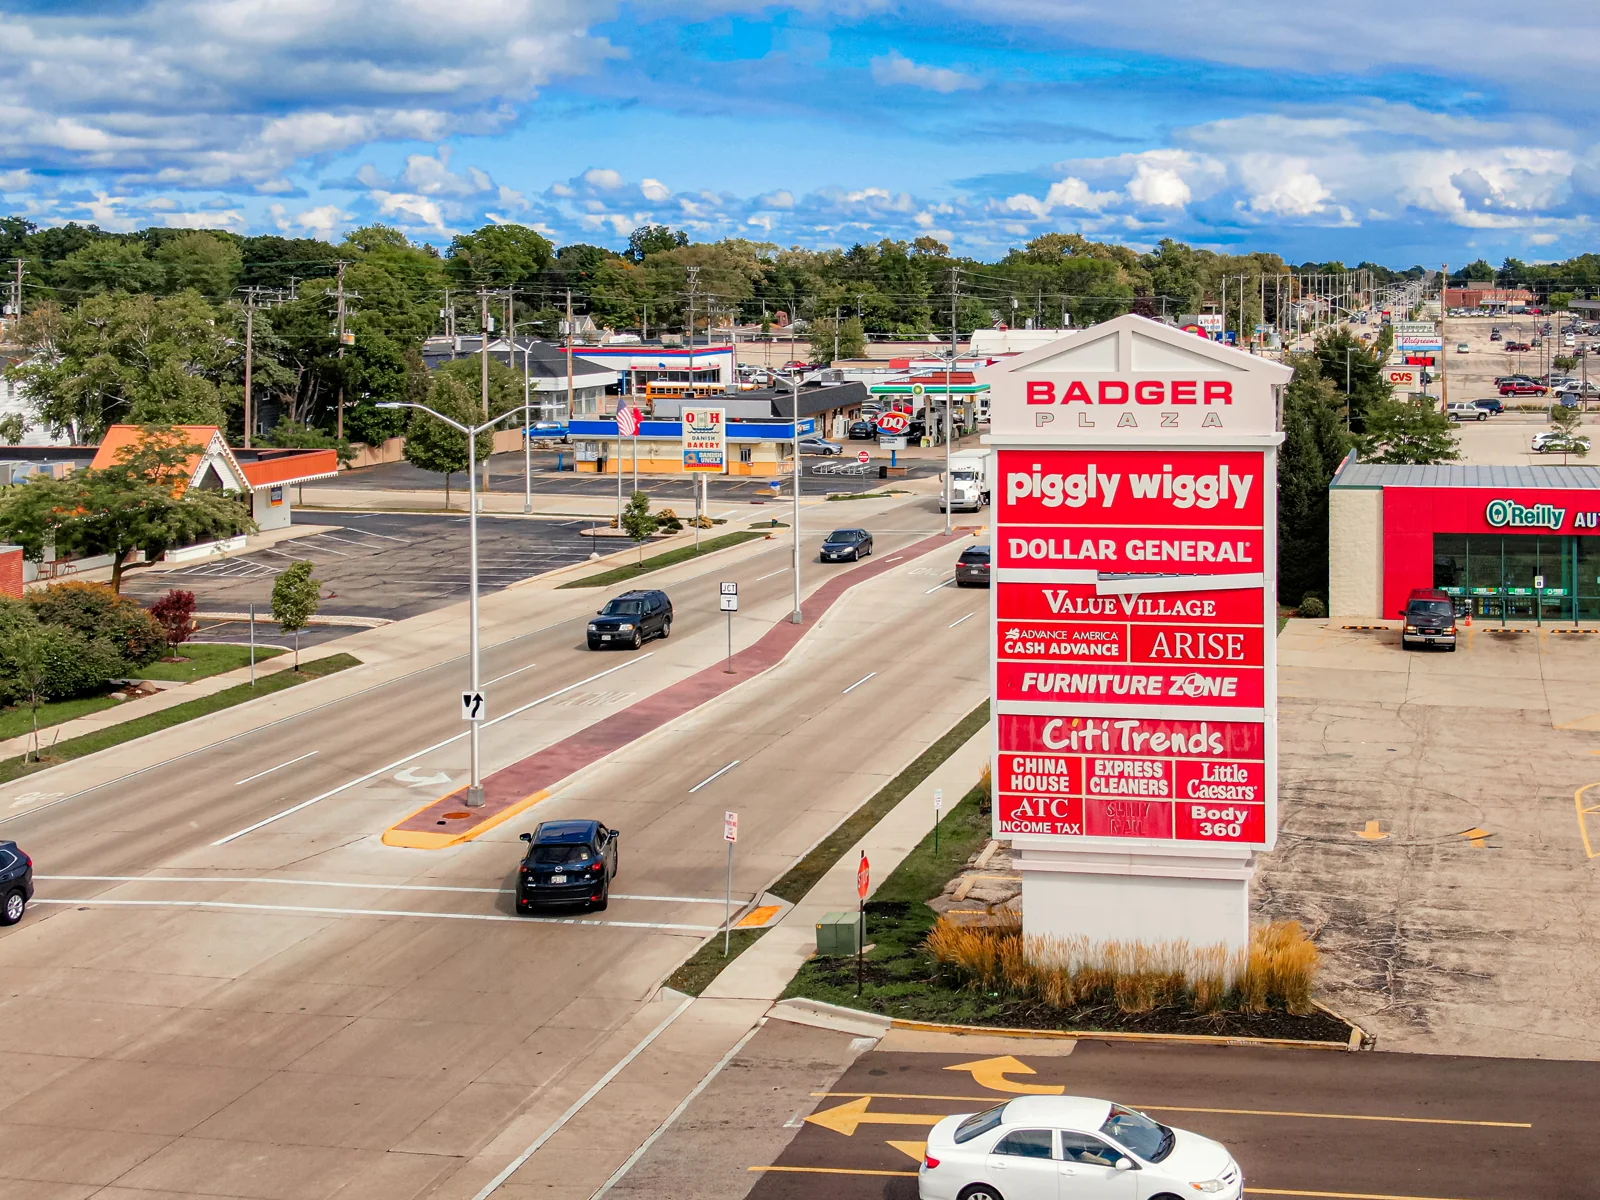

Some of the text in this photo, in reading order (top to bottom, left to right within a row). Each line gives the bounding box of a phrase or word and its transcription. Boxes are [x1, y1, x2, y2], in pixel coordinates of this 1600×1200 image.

[1403, 336, 1439, 346] Walgreens
[1390, 372, 1413, 382] CVS
[1027, 380, 1233, 405] BADGER
[882, 416, 904, 430] DQ
[1035, 412, 1223, 428] PLAZA
[1007, 464, 1253, 509] piggly wiggly
[1487, 500, 1600, 529] O'Reilly AU
[1008, 539, 1252, 562] DOLLAR GENERAL
[722, 584, 736, 592] JCT
[726, 600, 732, 608] T
[1020, 629, 1118, 641] ADVANCE AMERICA
[1004, 641, 1119, 656] CASH ADVANCE
[1149, 632, 1244, 660] ARISE
[1022, 672, 1238, 698] FURNITURE ZONE
[1012, 757, 1068, 775] CHINA
[1094, 760, 1163, 778] EXPRESS
[1201, 763, 1248, 783] Little
[1010, 774, 1070, 792] HOUSE
[1089, 778, 1169, 796] CLEANERS
[1187, 779, 1254, 801] Caesars
[1011, 798, 1069, 821] ATC
[1191, 806, 1248, 823] Body
[999, 820, 1081, 835] INCOME TAX
[1199, 822, 1242, 837] 360
